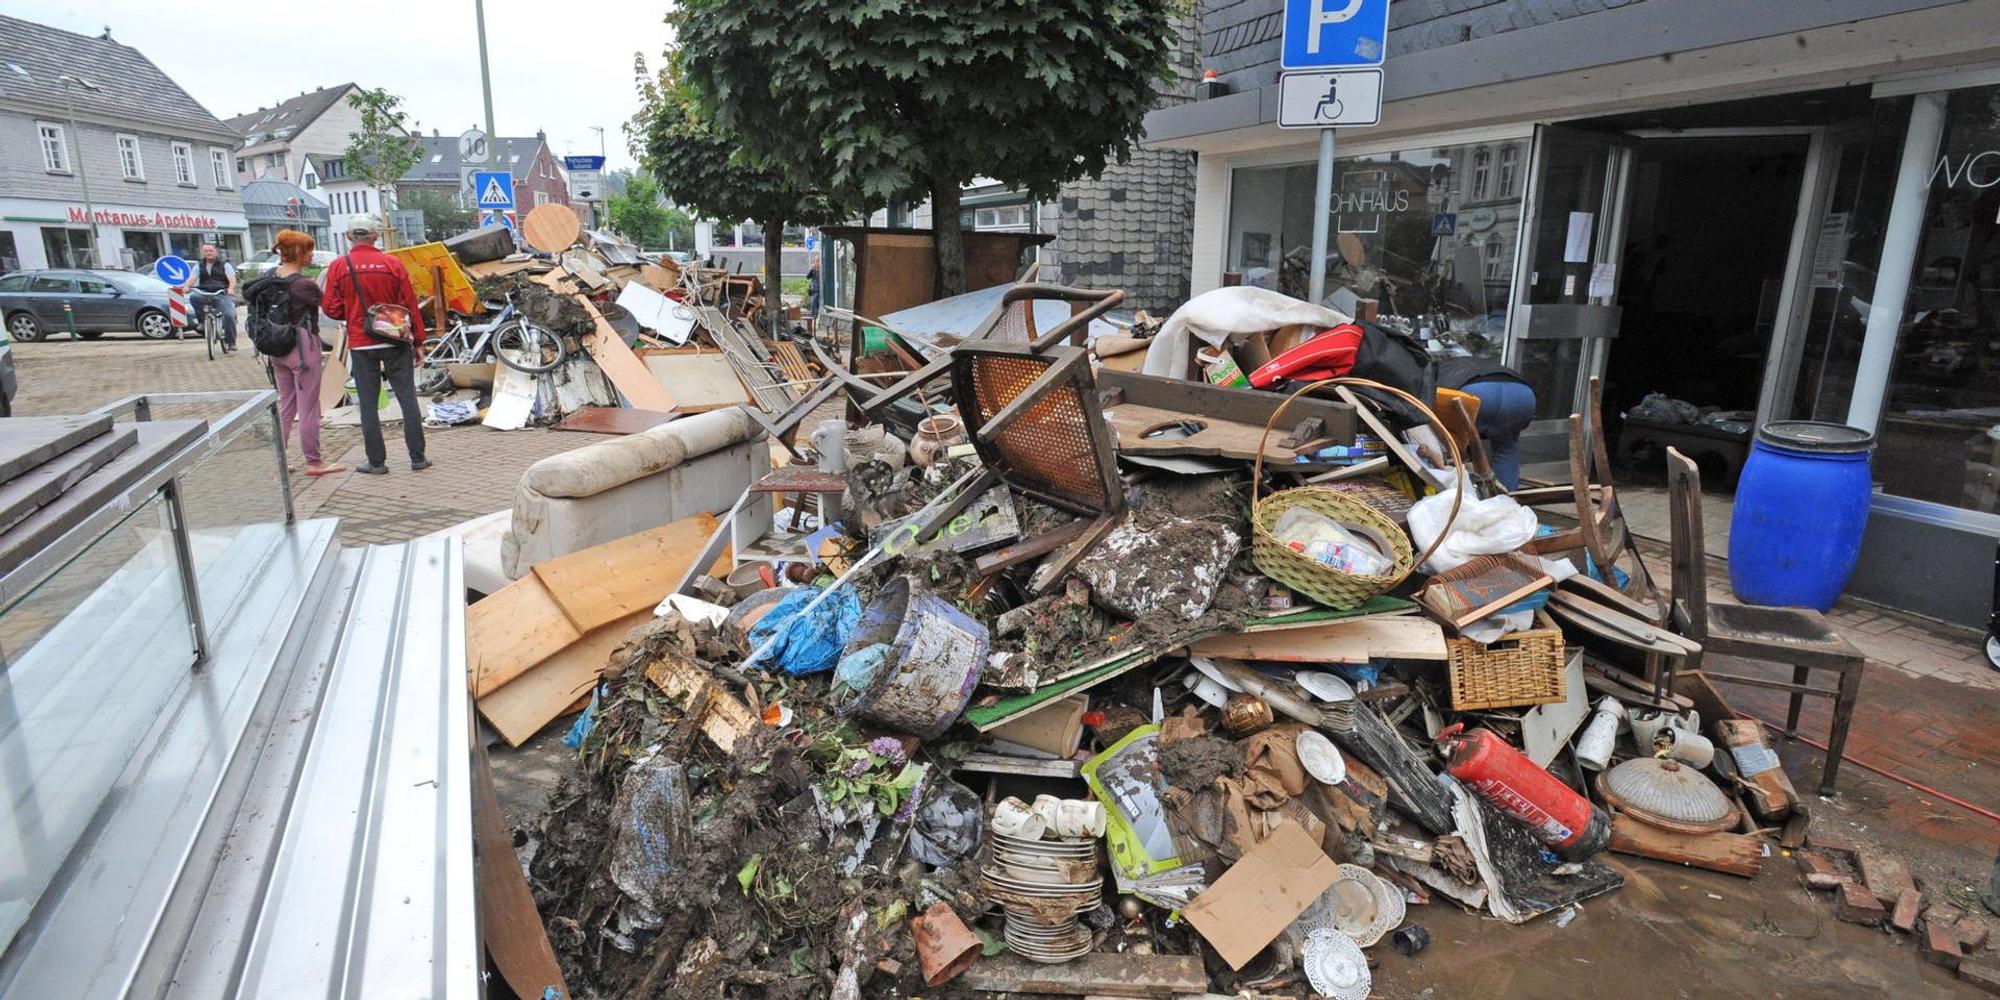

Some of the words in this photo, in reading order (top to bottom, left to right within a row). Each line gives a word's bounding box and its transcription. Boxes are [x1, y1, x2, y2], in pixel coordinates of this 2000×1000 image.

[1307, 0, 1364, 54] P
[466, 138, 485, 156] 10
[1329, 189, 1409, 214] OHNHAUS
